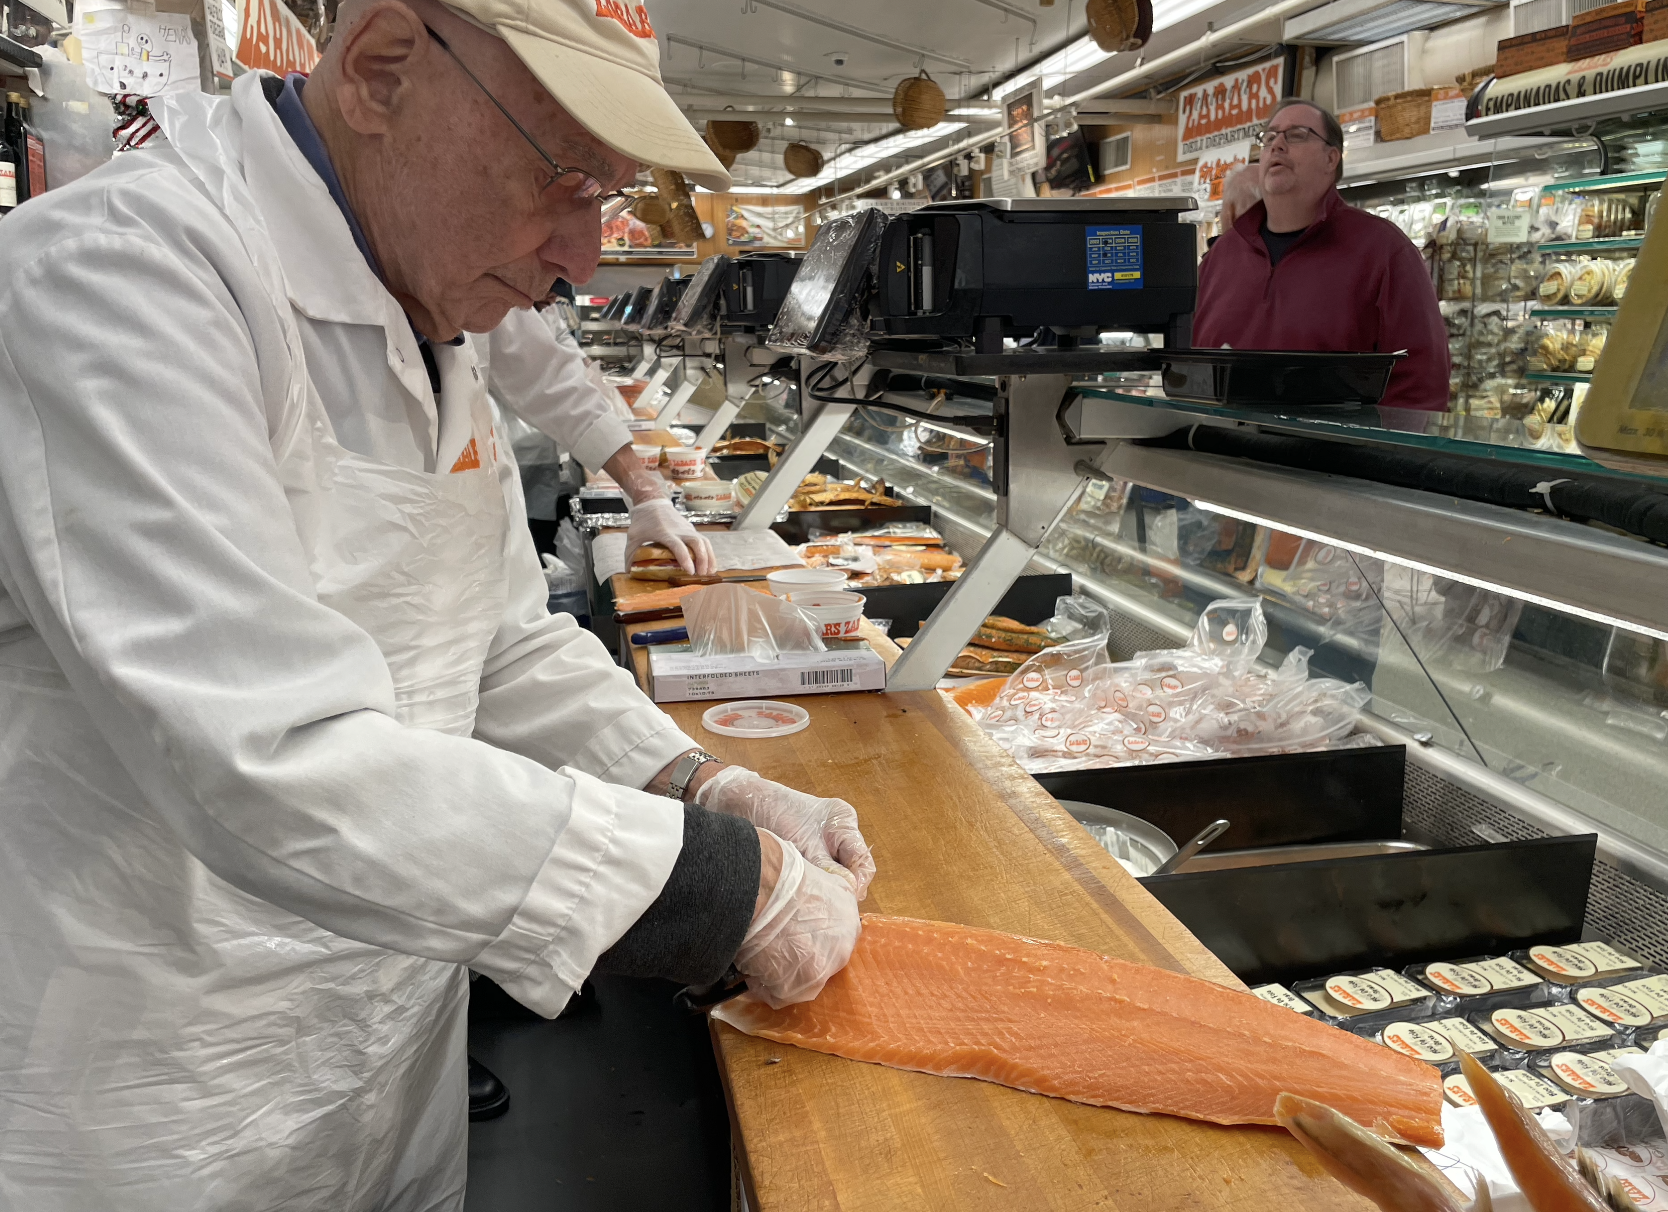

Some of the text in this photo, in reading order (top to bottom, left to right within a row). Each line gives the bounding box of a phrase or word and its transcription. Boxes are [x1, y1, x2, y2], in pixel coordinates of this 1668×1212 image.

[1486, 78, 1571, 116] EMPANADAS
[1182, 138, 1204, 155] DELI
[1089, 272, 1112, 283] NYC
[687, 672, 732, 680] INTERFOLDED
